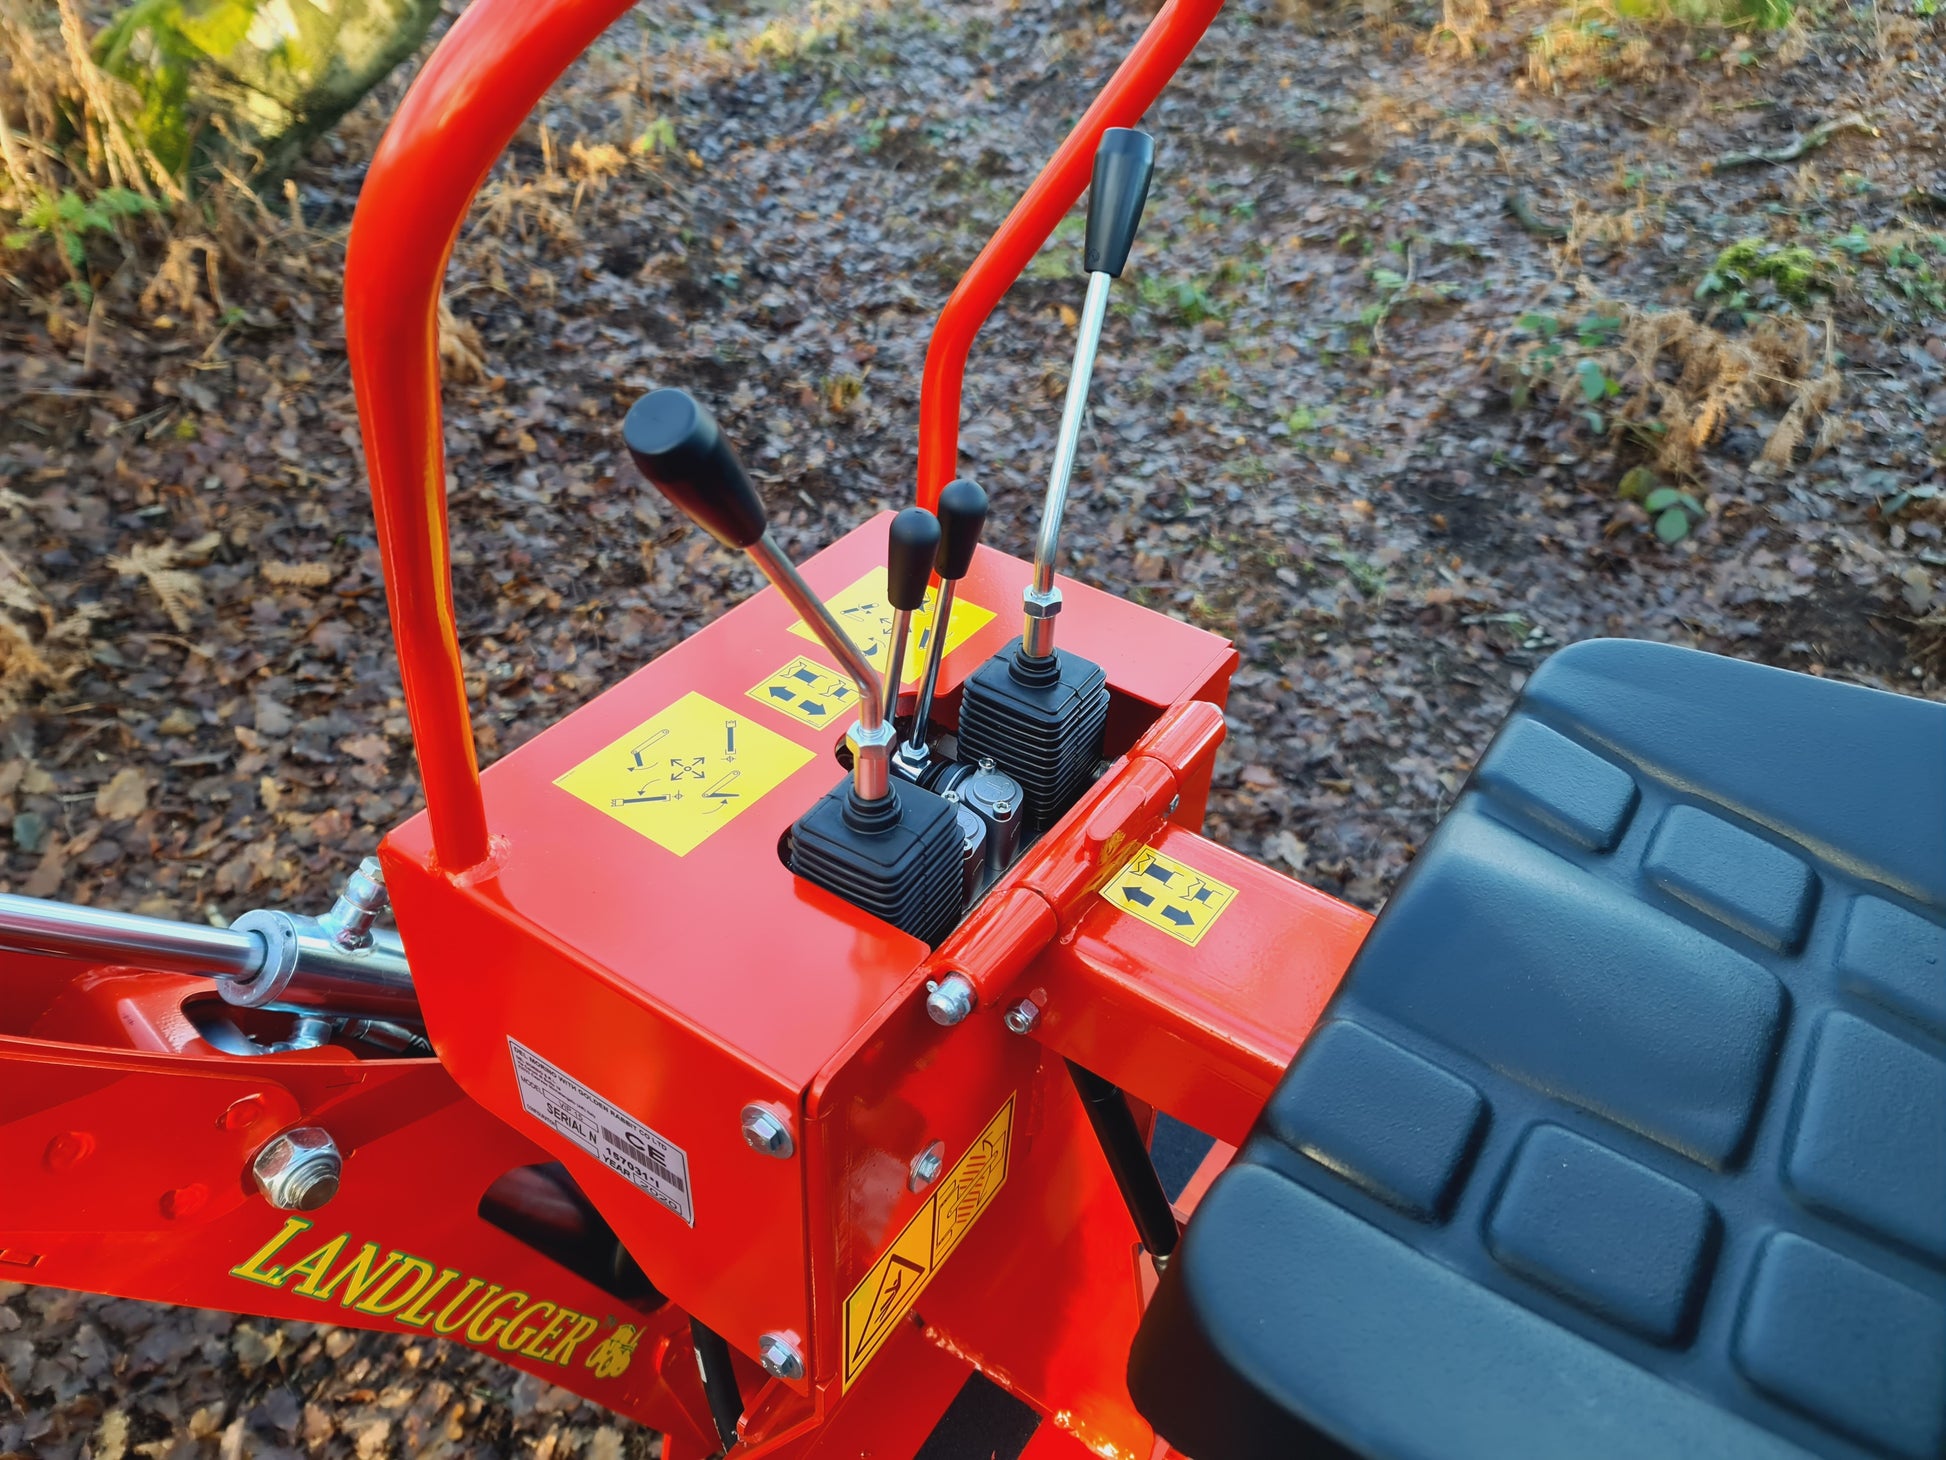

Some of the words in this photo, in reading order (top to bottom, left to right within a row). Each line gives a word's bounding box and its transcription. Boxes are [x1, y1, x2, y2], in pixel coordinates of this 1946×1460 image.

[519, 1074, 543, 1095] MODEL
[545, 1100, 586, 1138] SERIAL
[587, 1129, 598, 1145] N
[558, 1075, 577, 1092] WITH
[577, 1088, 609, 1114] GOLDEN
[609, 1109, 637, 1133] RABBIT
[638, 1128, 650, 1141] CO
[651, 1136, 667, 1152] LTD
[625, 1131, 666, 1167] CE
[602, 1153, 631, 1180] YEAR
[639, 1179, 678, 1212] 2020
[229, 1216, 599, 1367] LANDLUGGER
